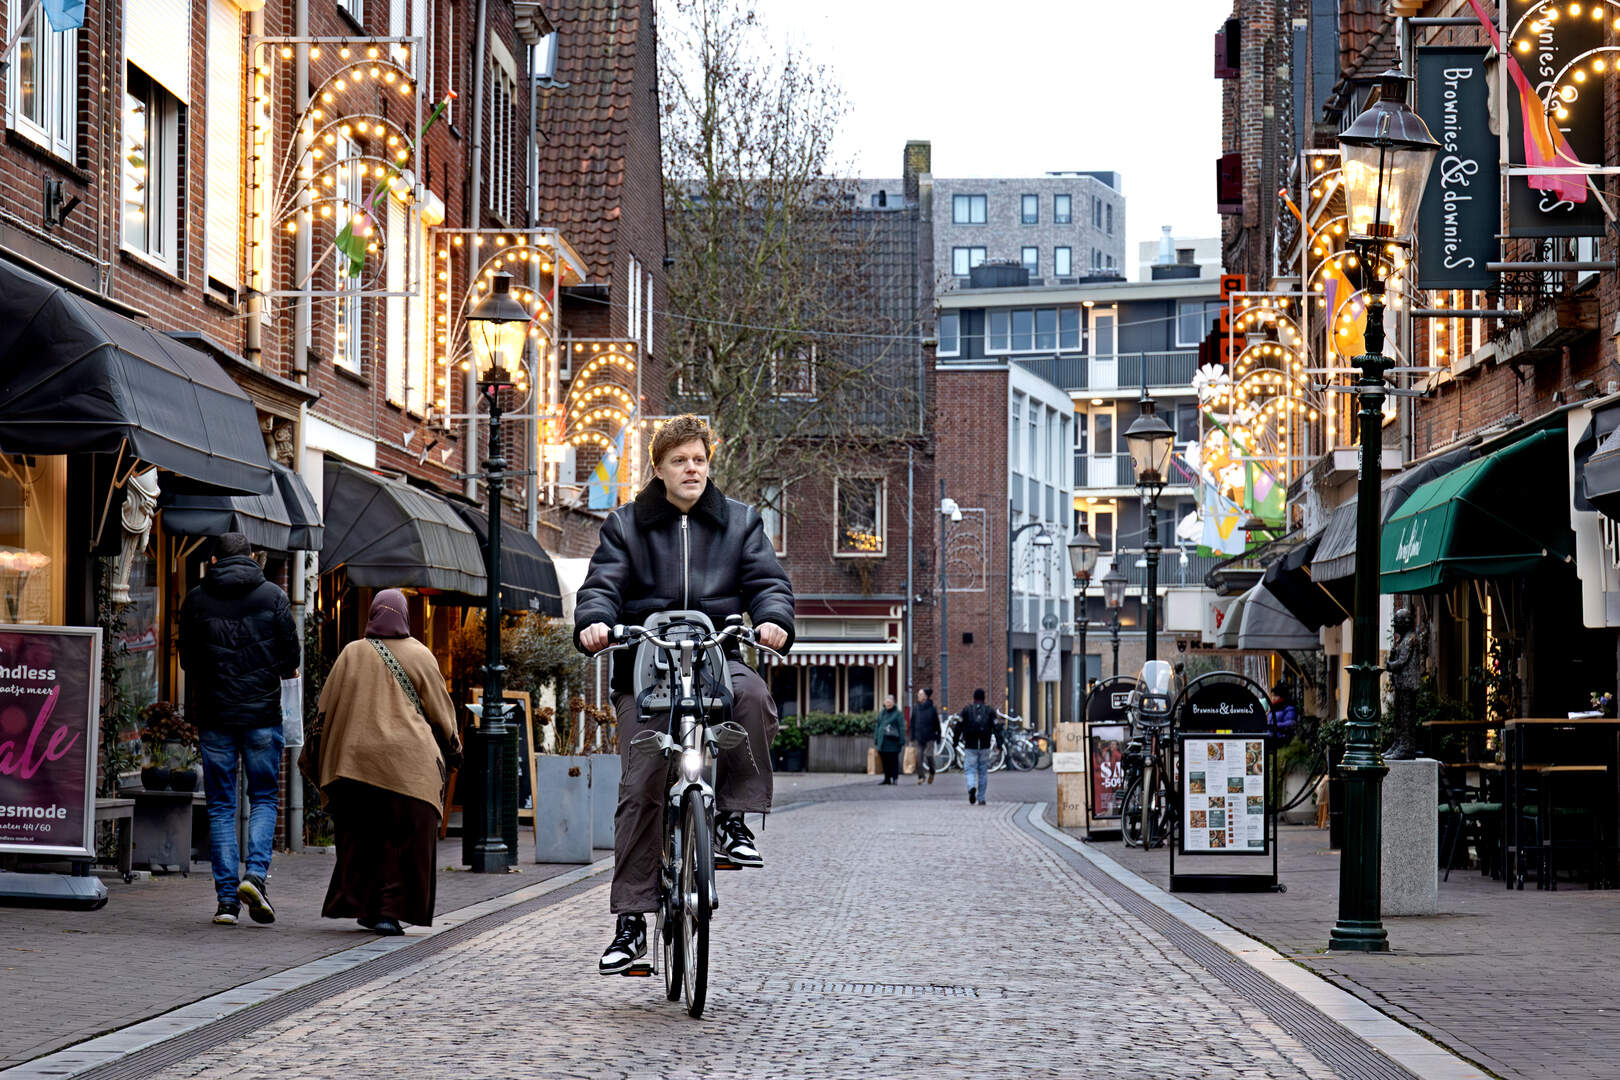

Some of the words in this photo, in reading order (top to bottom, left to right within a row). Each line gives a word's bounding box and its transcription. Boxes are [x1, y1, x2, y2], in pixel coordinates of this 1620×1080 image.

[0, 665, 57, 680] ndless
[0, 684, 25, 697] aatje
[0, 684, 80, 779] ale
[0, 804, 67, 819] esmode
[0, 822, 21, 832] aten
